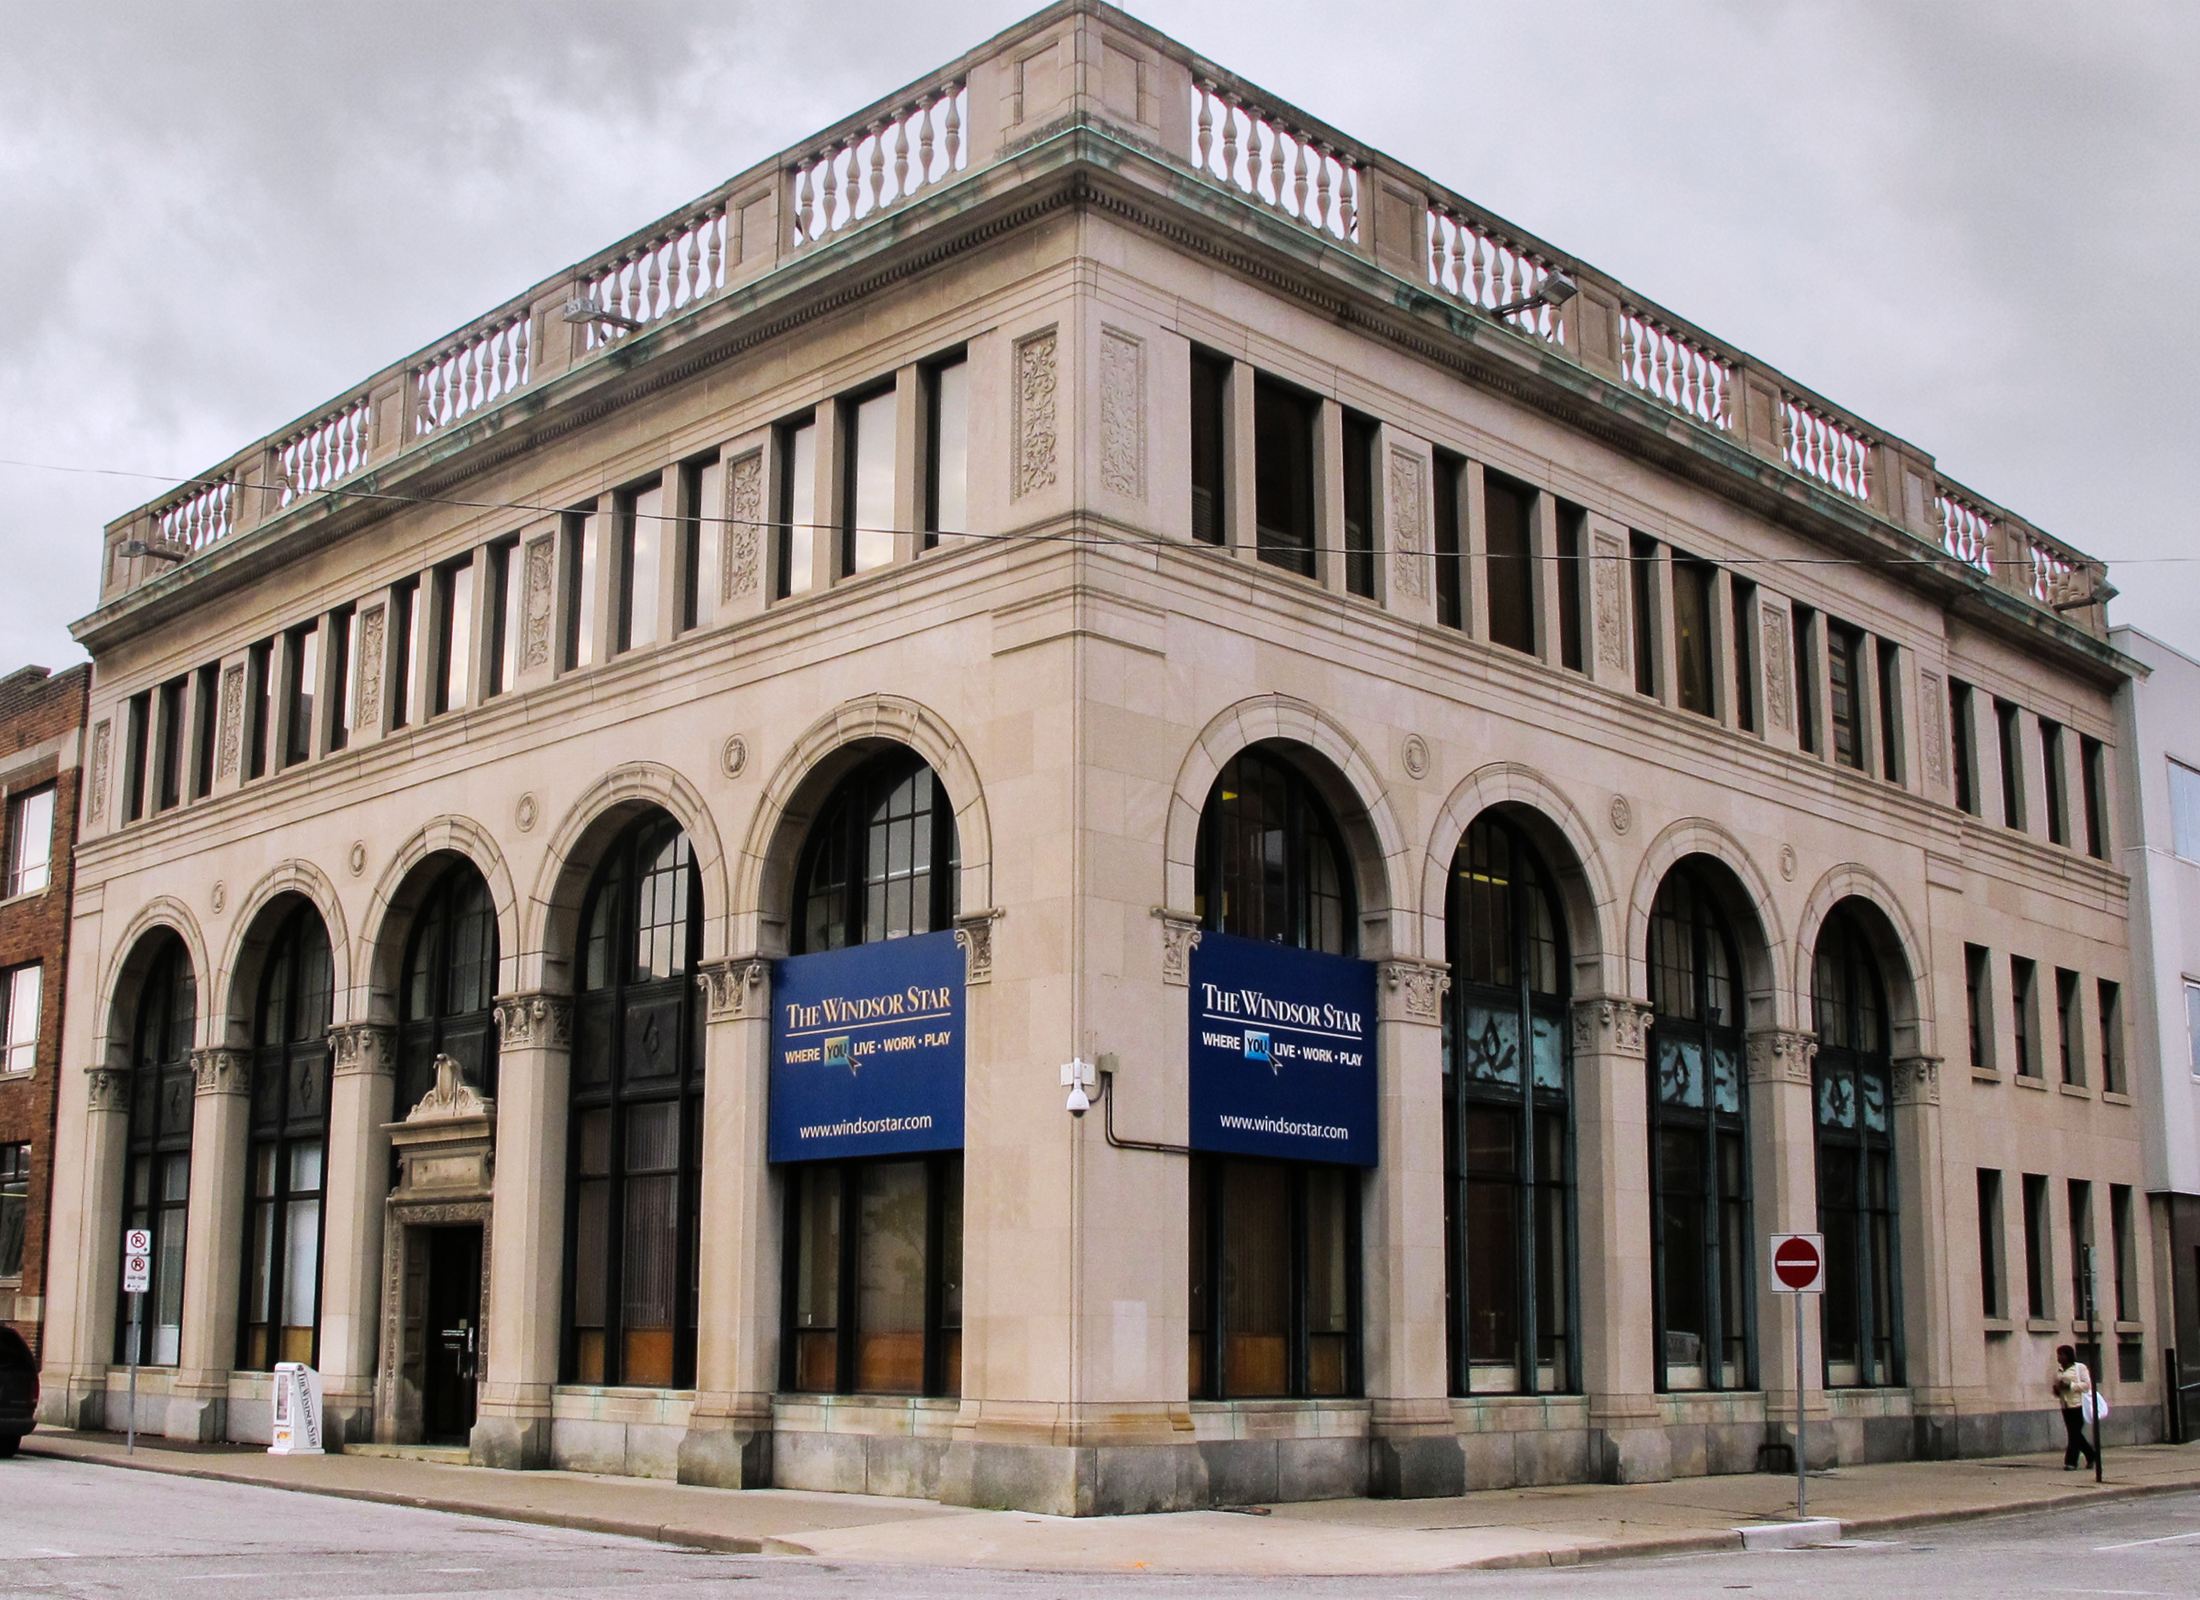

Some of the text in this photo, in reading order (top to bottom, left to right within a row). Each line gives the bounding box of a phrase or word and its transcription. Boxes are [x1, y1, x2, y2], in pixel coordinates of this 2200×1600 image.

[786, 986, 951, 1029] THE WINDSOR STAR
[1202, 983, 1362, 1032] THE WINDSOR STAR
[785, 1031, 951, 1064] WHERE YOU LIVE WORK PLAY
[1202, 1031, 1363, 1067] WHERE YOU LIVE WORK PLAY
[800, 1114, 932, 1139] www.windsorstar.com
[1219, 1114, 1349, 1140] www.windsorstar.com
